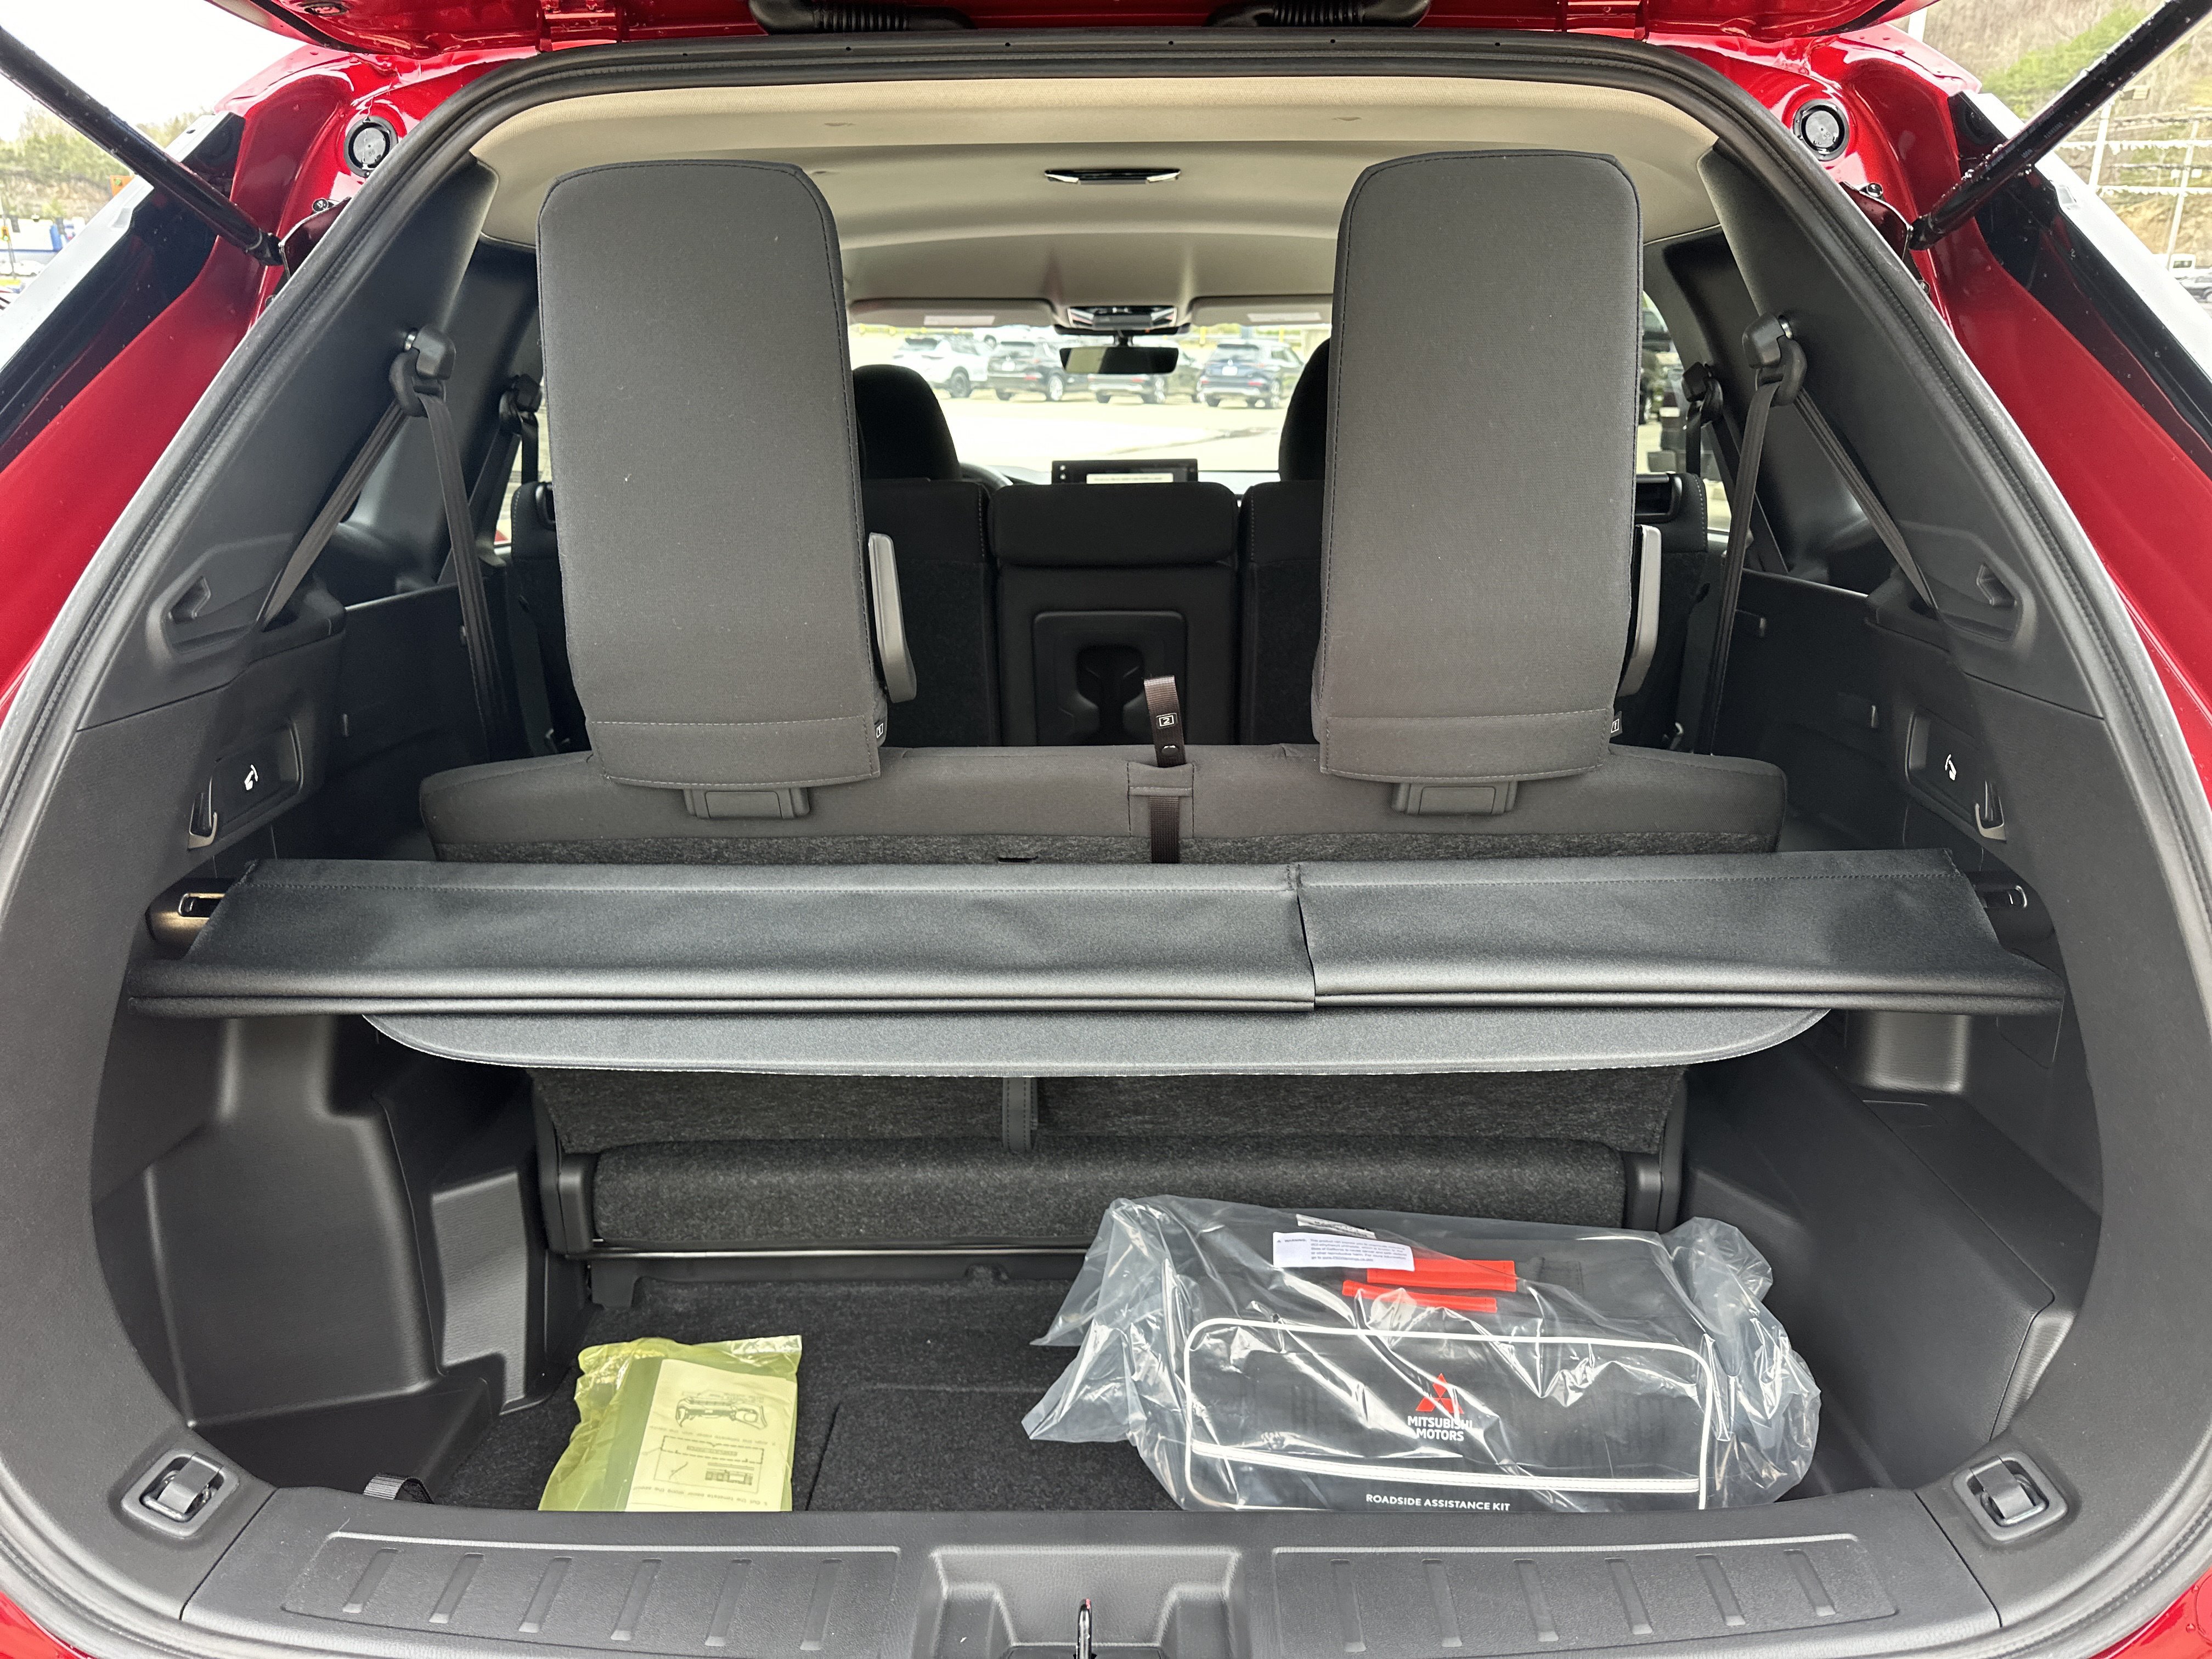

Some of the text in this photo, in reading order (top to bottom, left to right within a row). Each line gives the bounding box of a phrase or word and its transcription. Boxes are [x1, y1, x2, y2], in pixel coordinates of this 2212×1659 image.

[1408, 1415, 1472, 1429] MITSUBISHI
[1415, 1428, 1464, 1441] MOTORS
[1366, 1494, 1510, 1511] ROADSIDE ASSISTANCE KIT
